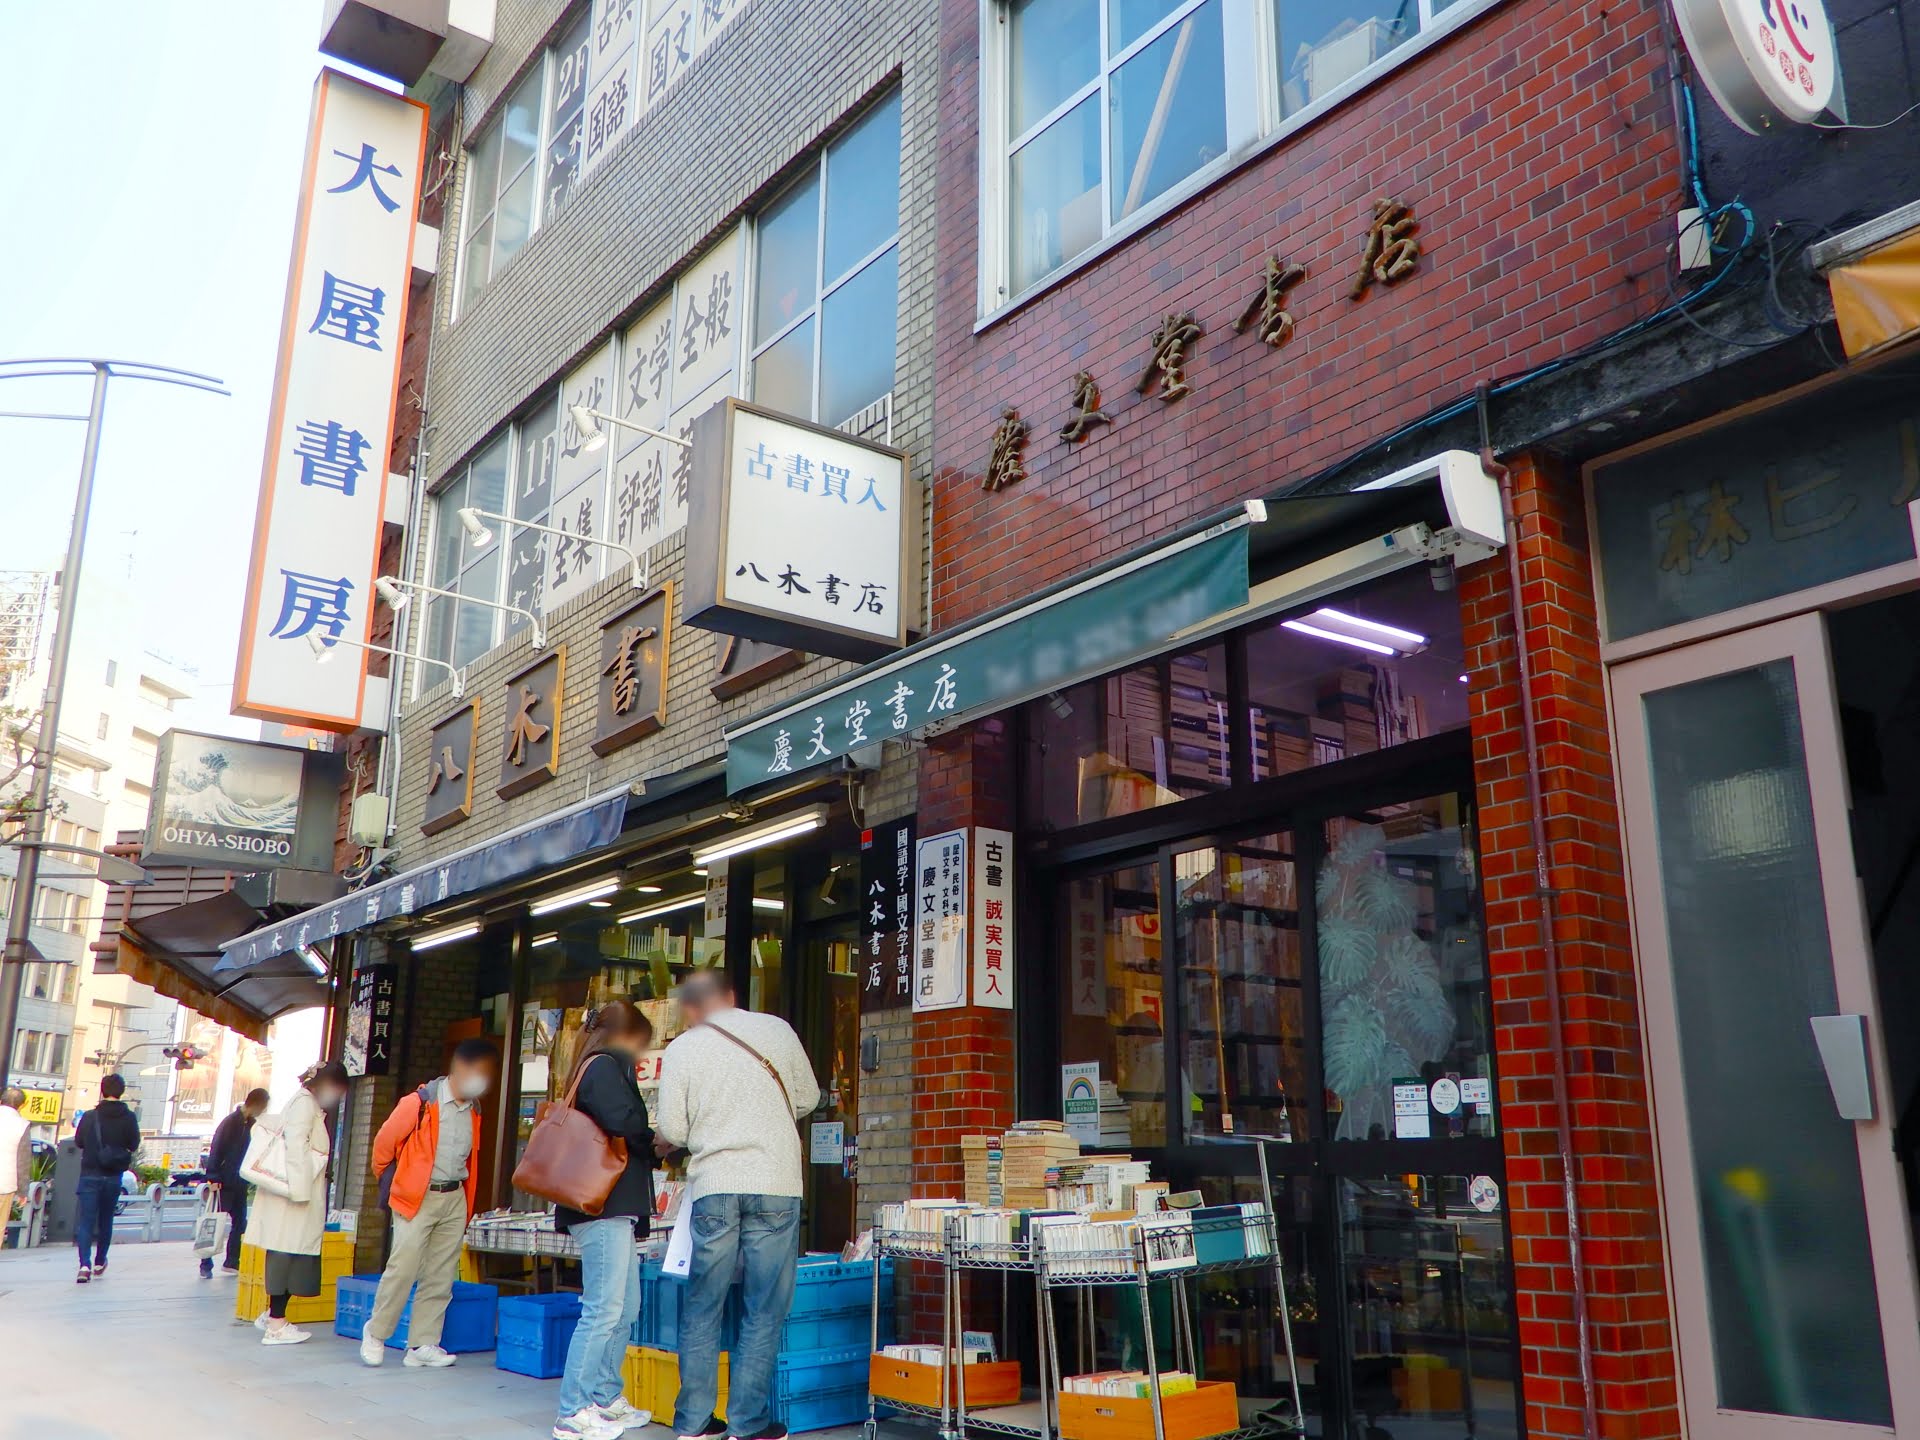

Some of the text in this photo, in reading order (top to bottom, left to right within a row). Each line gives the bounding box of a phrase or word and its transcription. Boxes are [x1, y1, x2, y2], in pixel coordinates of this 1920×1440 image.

[557, 43, 589, 112] 2F
[587, 68, 630, 164] 国語
[624, 318, 672, 420] 文学
[680, 271, 732, 374] 全般
[268, 142, 403, 648] 大屋書房
[523, 432, 555, 499] 1F
[745, 442, 888, 512] 古書買入
[552, 497, 593, 591] 全集
[618, 450, 662, 546] 評論
[736, 562, 888, 615] 八木書店
[767, 663, 959, 775] 慶文堂書店
[163, 828, 291, 857] OHYA-SHOBO
[865, 879, 886, 992] 八木書店
[920, 866, 937, 996] 慶文堂書店
[985, 840, 1003, 996] 古書 誠実買入
[372, 979, 393, 1060] 古書買入
[24, 1096, 57, 1115] 豚山
